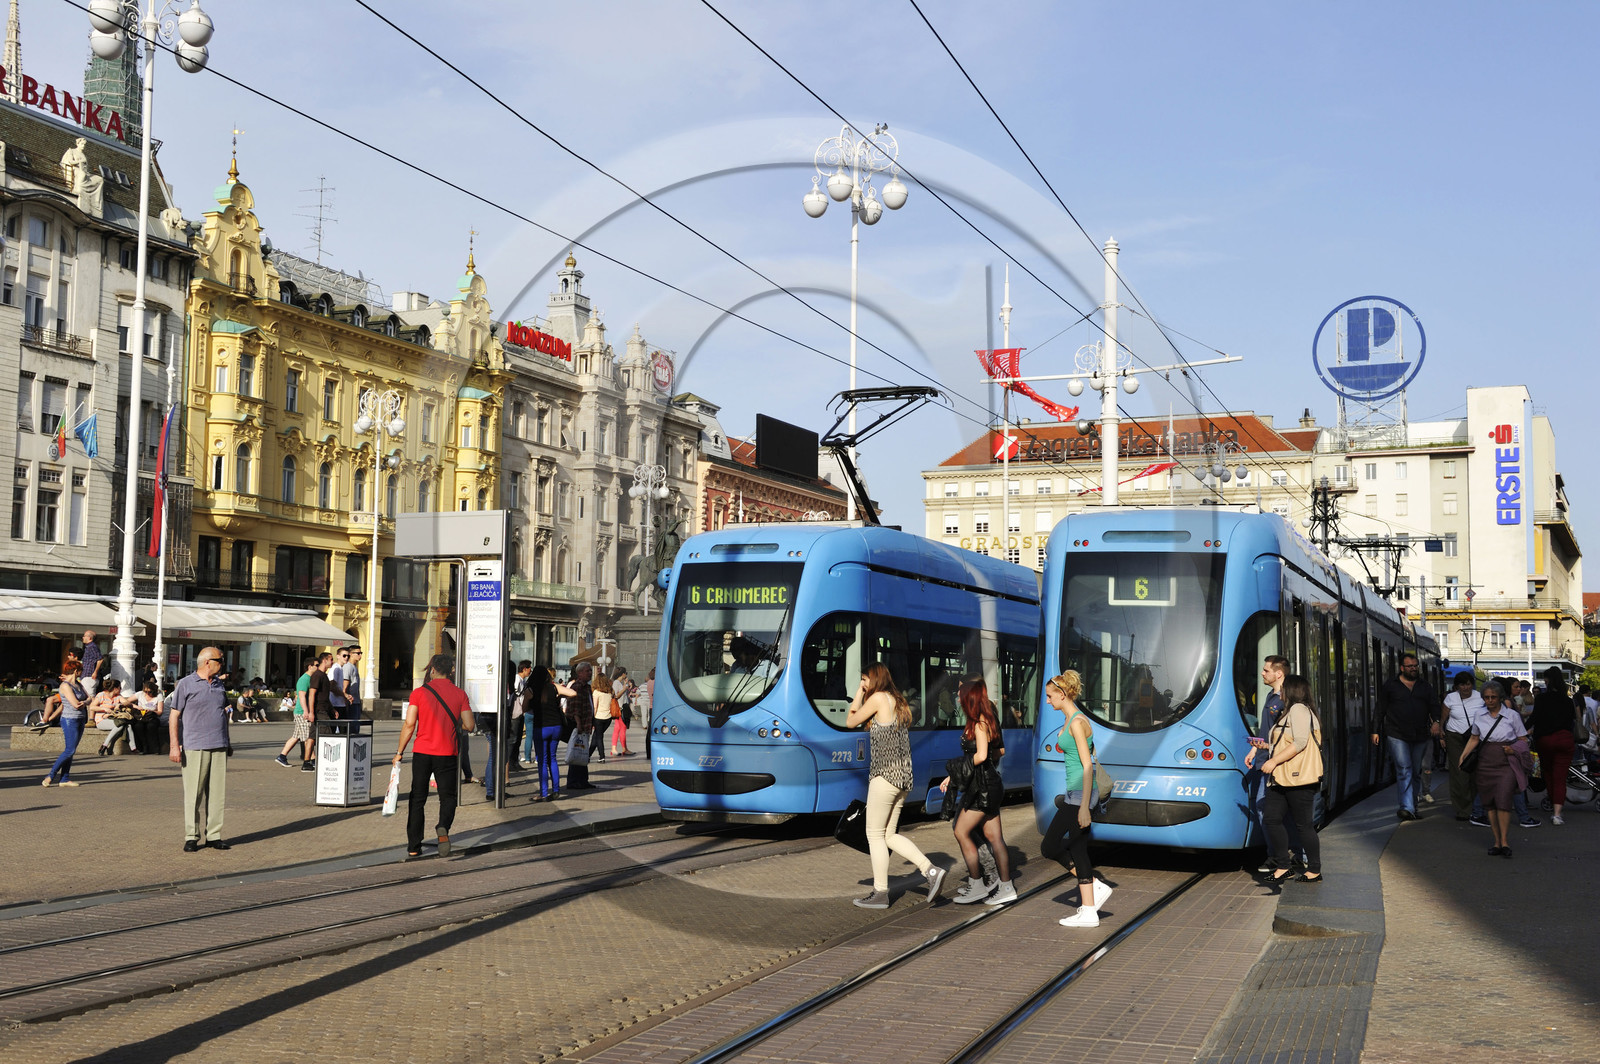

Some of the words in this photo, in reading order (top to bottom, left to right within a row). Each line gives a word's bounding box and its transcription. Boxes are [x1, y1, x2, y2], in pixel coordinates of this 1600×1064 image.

[20, 74, 125, 141] BANKA
[507, 321, 571, 362] KONZUM
[1026, 427, 1157, 463] Zagrebčka
[1495, 447, 1521, 525] ERSTE
[691, 585, 701, 604] 6
[1135, 577, 1148, 600] 6
[656, 756, 675, 766] 2273
[831, 751, 853, 763] 2273
[1113, 780, 1149, 794] ZET
[1176, 786, 1208, 797] 2247
